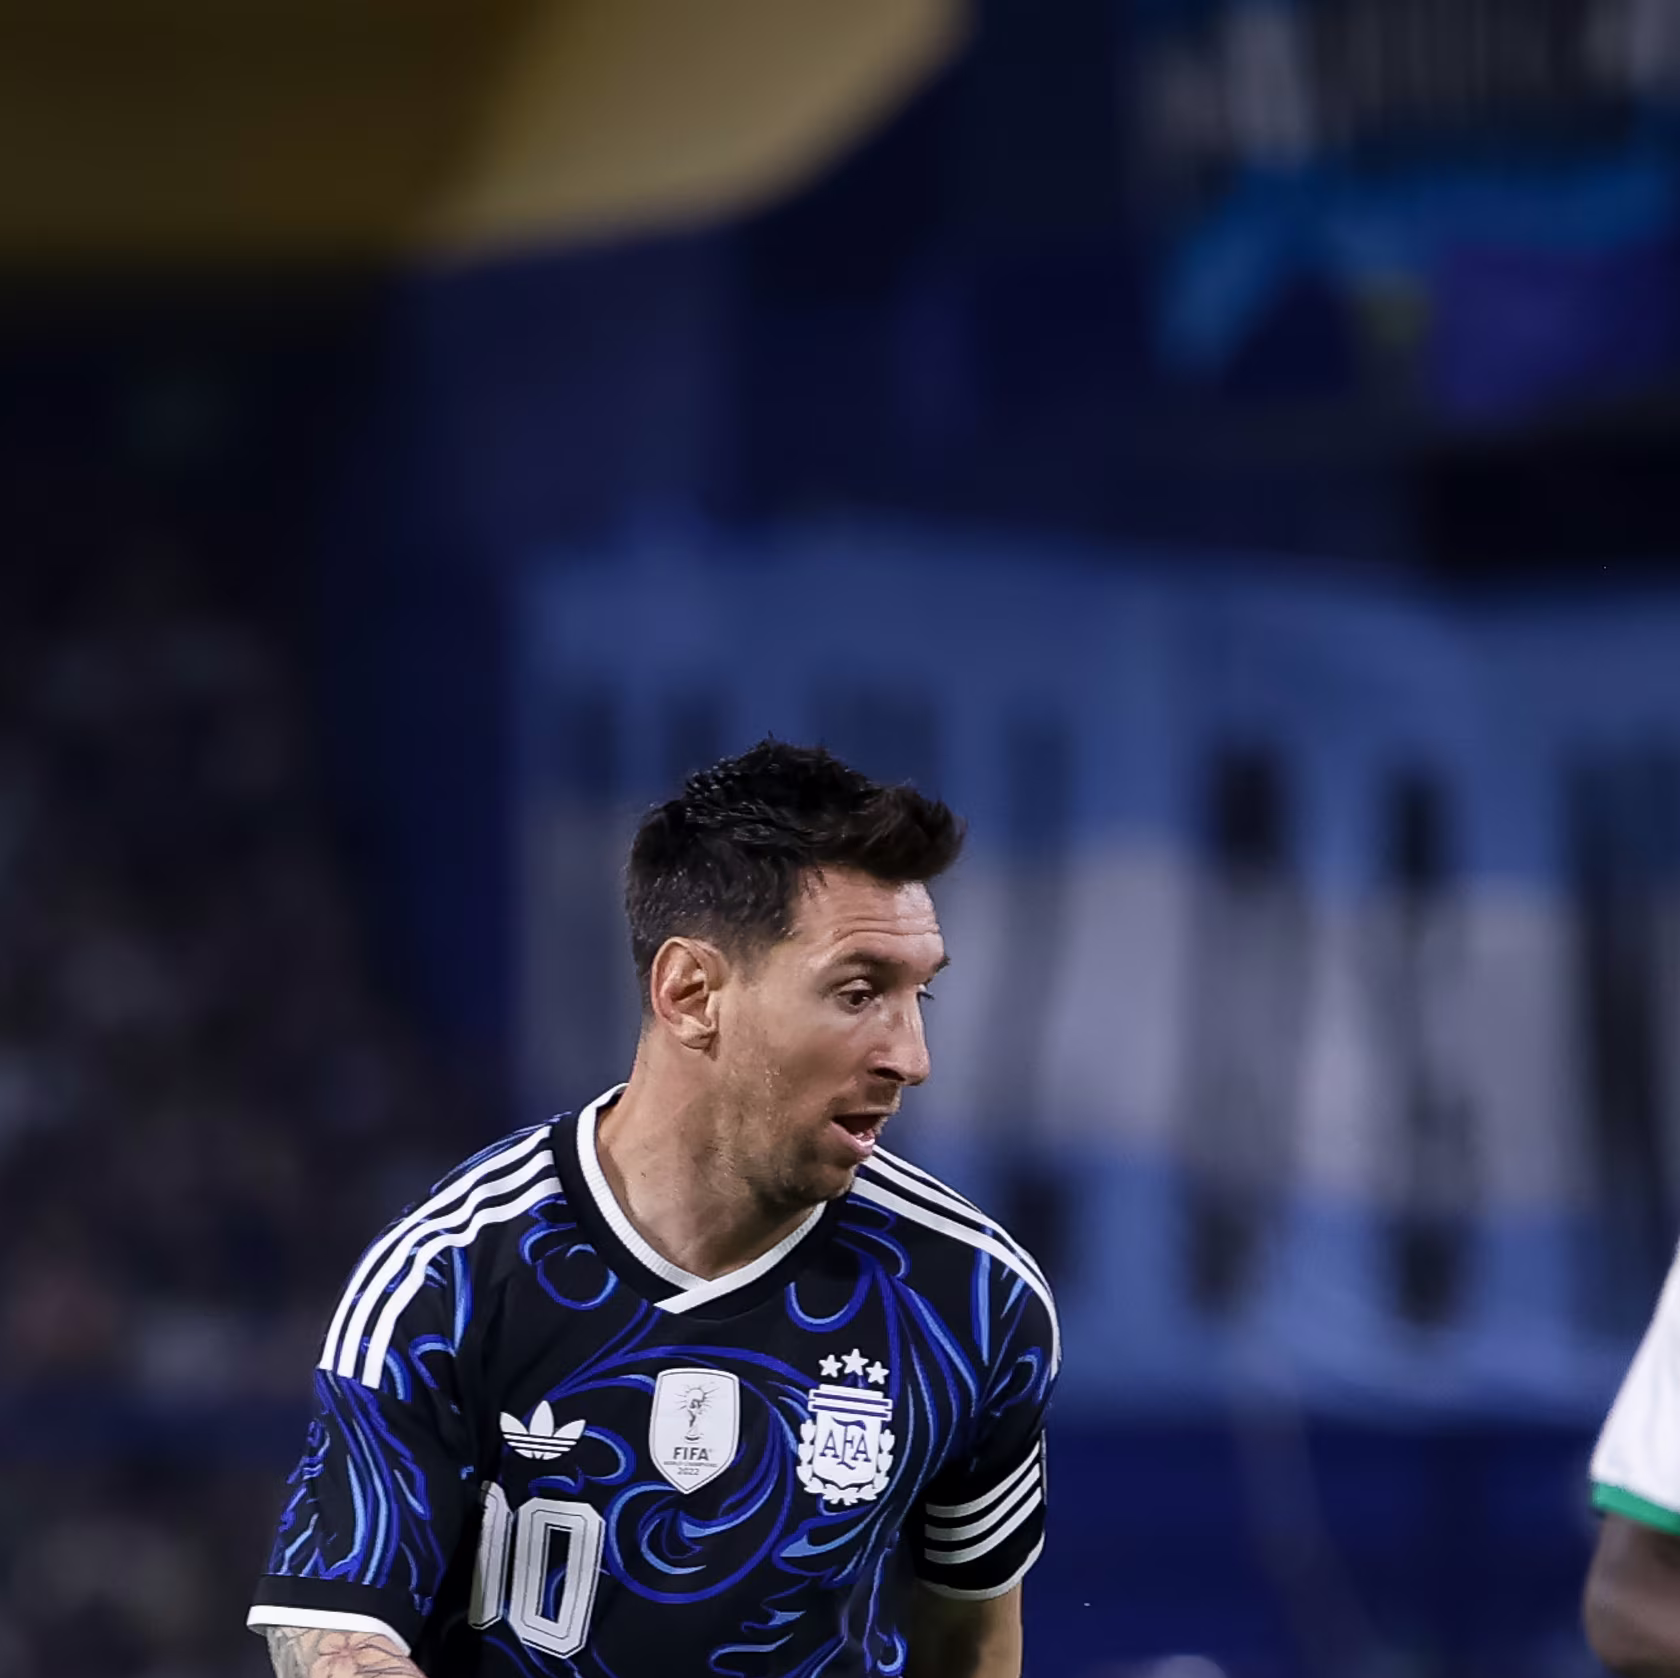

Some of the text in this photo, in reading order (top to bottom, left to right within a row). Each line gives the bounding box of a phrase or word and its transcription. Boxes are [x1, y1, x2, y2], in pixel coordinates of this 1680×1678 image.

[673, 1446, 709, 1461] FIFA
[819, 1416, 872, 1470] AFA
[468, 1480, 607, 1660] 10
